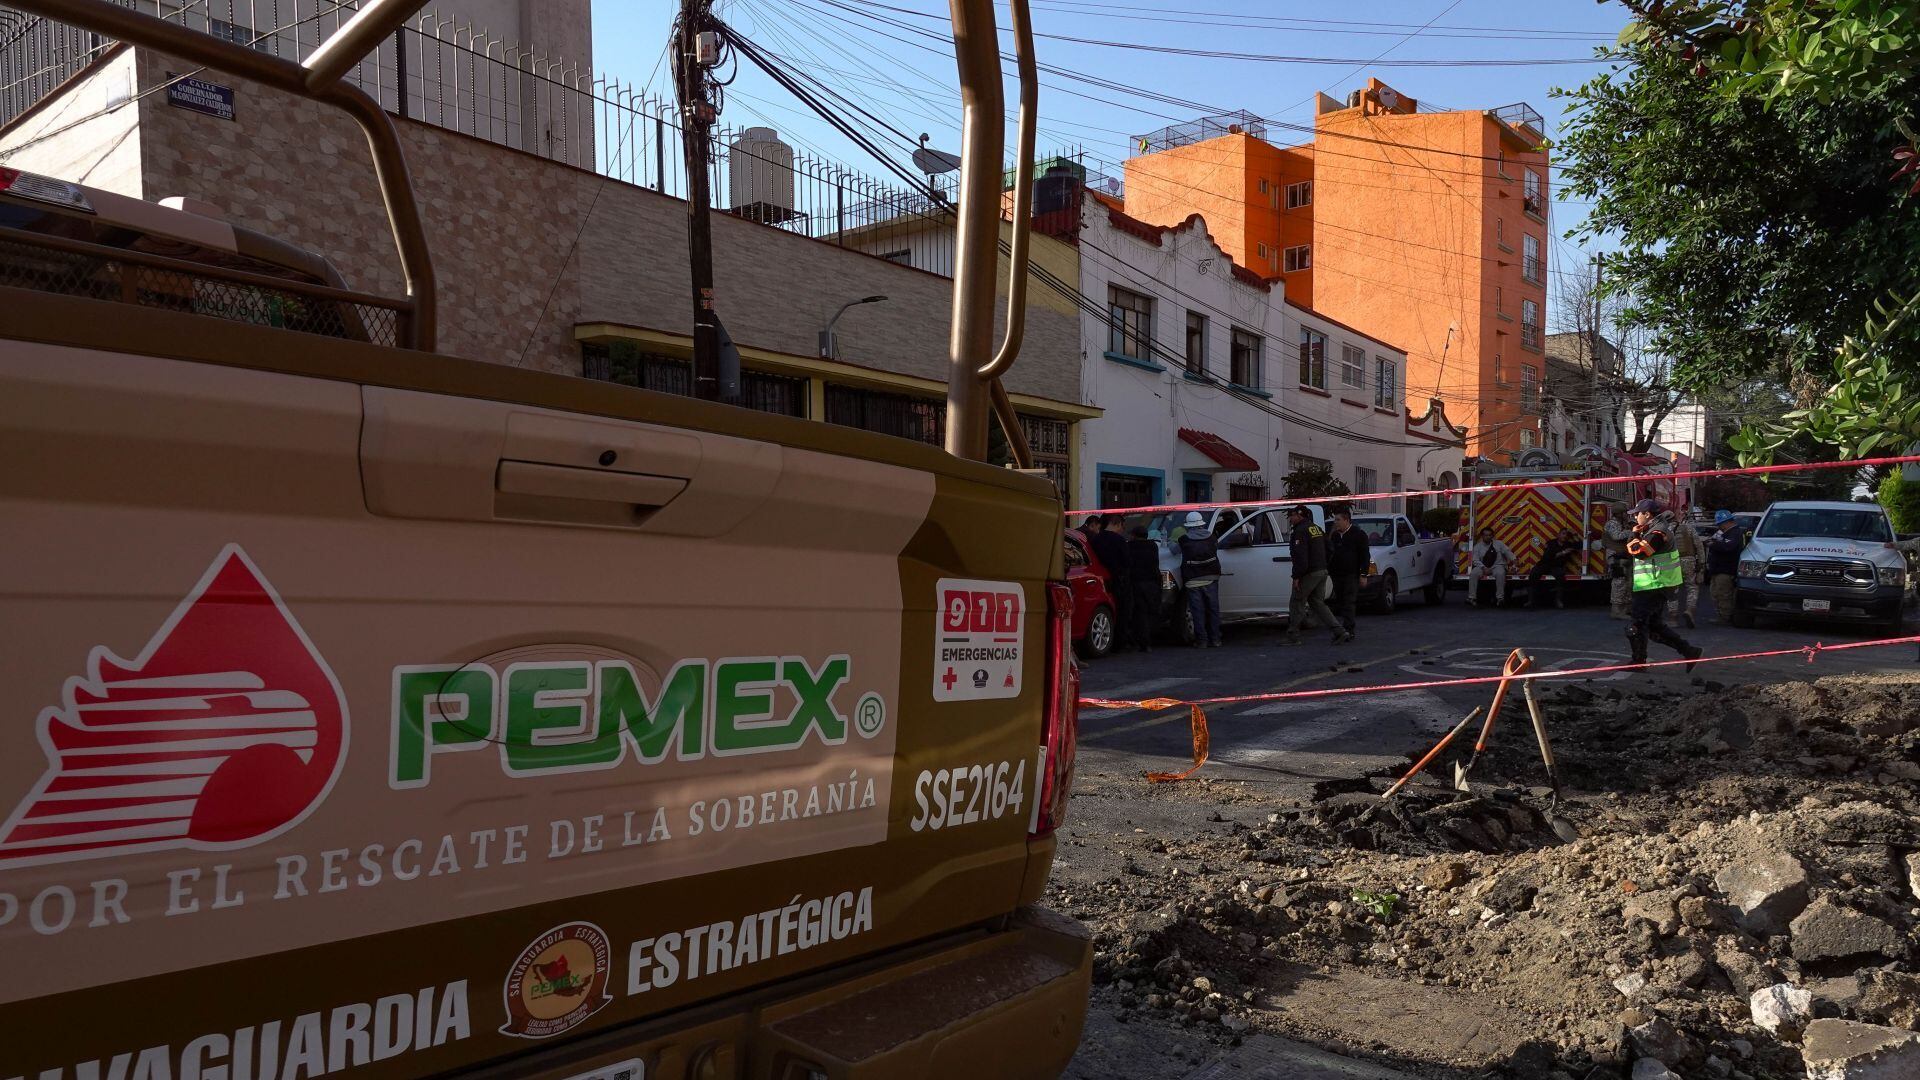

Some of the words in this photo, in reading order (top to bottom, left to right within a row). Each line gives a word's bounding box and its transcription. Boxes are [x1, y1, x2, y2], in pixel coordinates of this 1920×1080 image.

[177, 83, 223, 102] GOBERNADOR
[190, 80, 217, 92] CALLE
[949, 597, 1013, 627] 911
[941, 647, 1018, 662] EMERGENCIAS
[388, 654, 851, 790] PEMEX
[910, 759, 1026, 832] SSE2164
[164, 864, 244, 917] EL
[273, 825, 529, 900] RESCATE
[547, 814, 604, 860] DE
[621, 807, 671, 848] LA
[687, 770, 877, 837] SOBERANÍA
[509, 931, 565, 997] SALVAGUARDIA
[627, 886, 874, 997] ESTRATÉGICA
